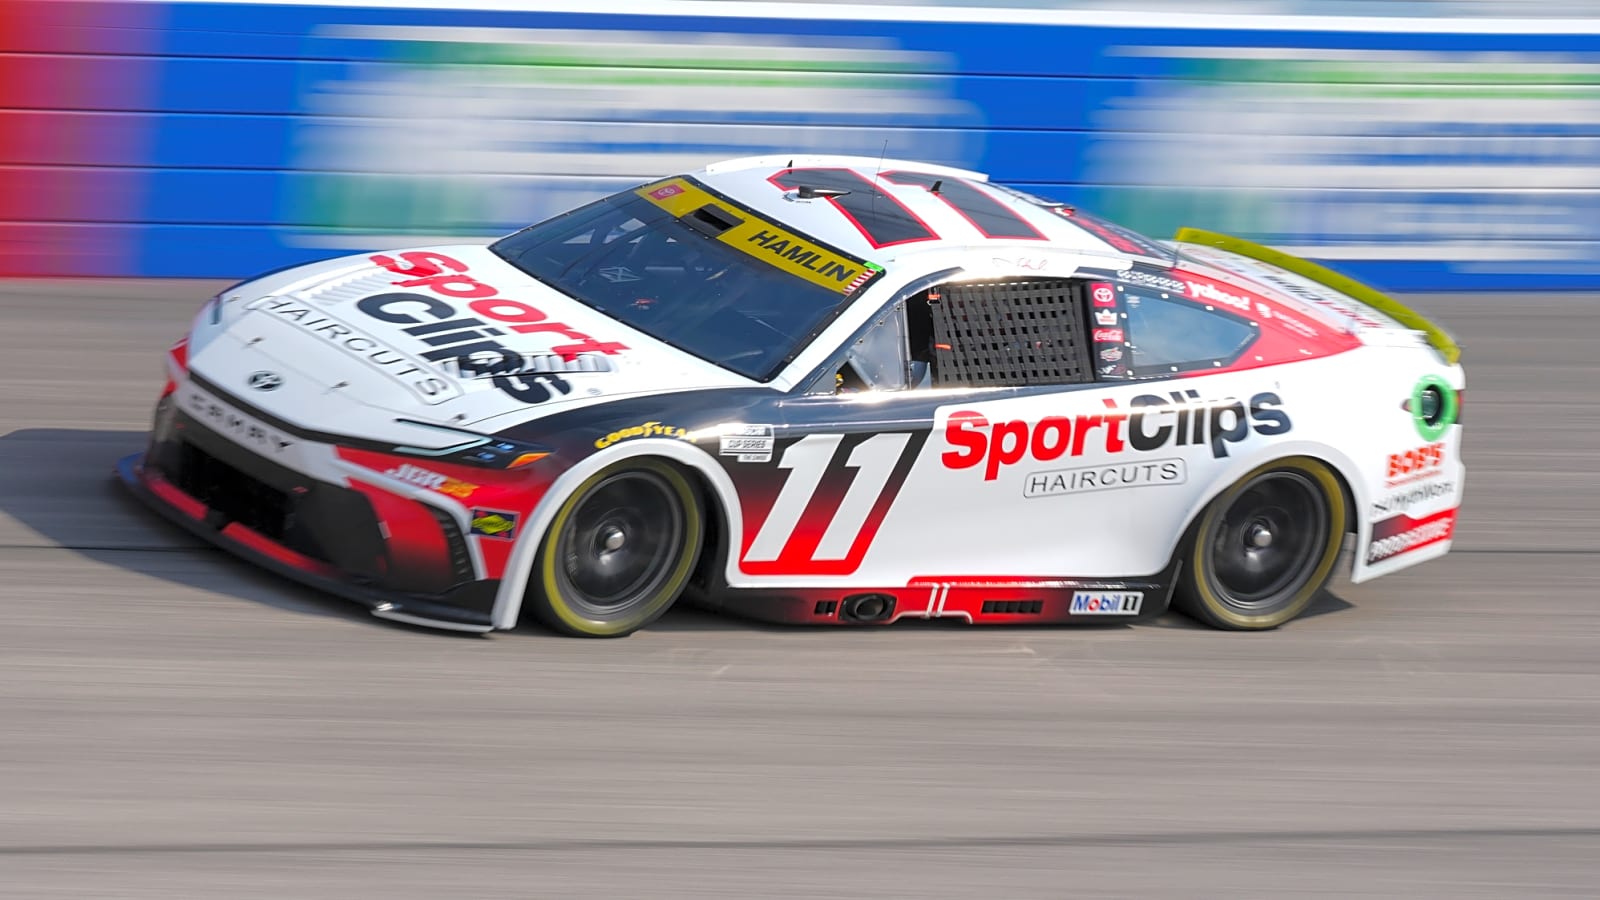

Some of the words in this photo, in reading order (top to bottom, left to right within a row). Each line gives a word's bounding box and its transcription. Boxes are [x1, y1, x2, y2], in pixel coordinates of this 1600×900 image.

[747, 230, 857, 282] HAMLIN
[370, 251, 630, 362] Sport
[262, 295, 450, 397] HAIRCUTS
[356, 292, 571, 404] Clips
[594, 421, 698, 449] GOODYEA
[741, 432, 913, 562] 11
[1030, 462, 1179, 494] HAIRCUTS
[1073, 594, 1121, 612] Mobil
